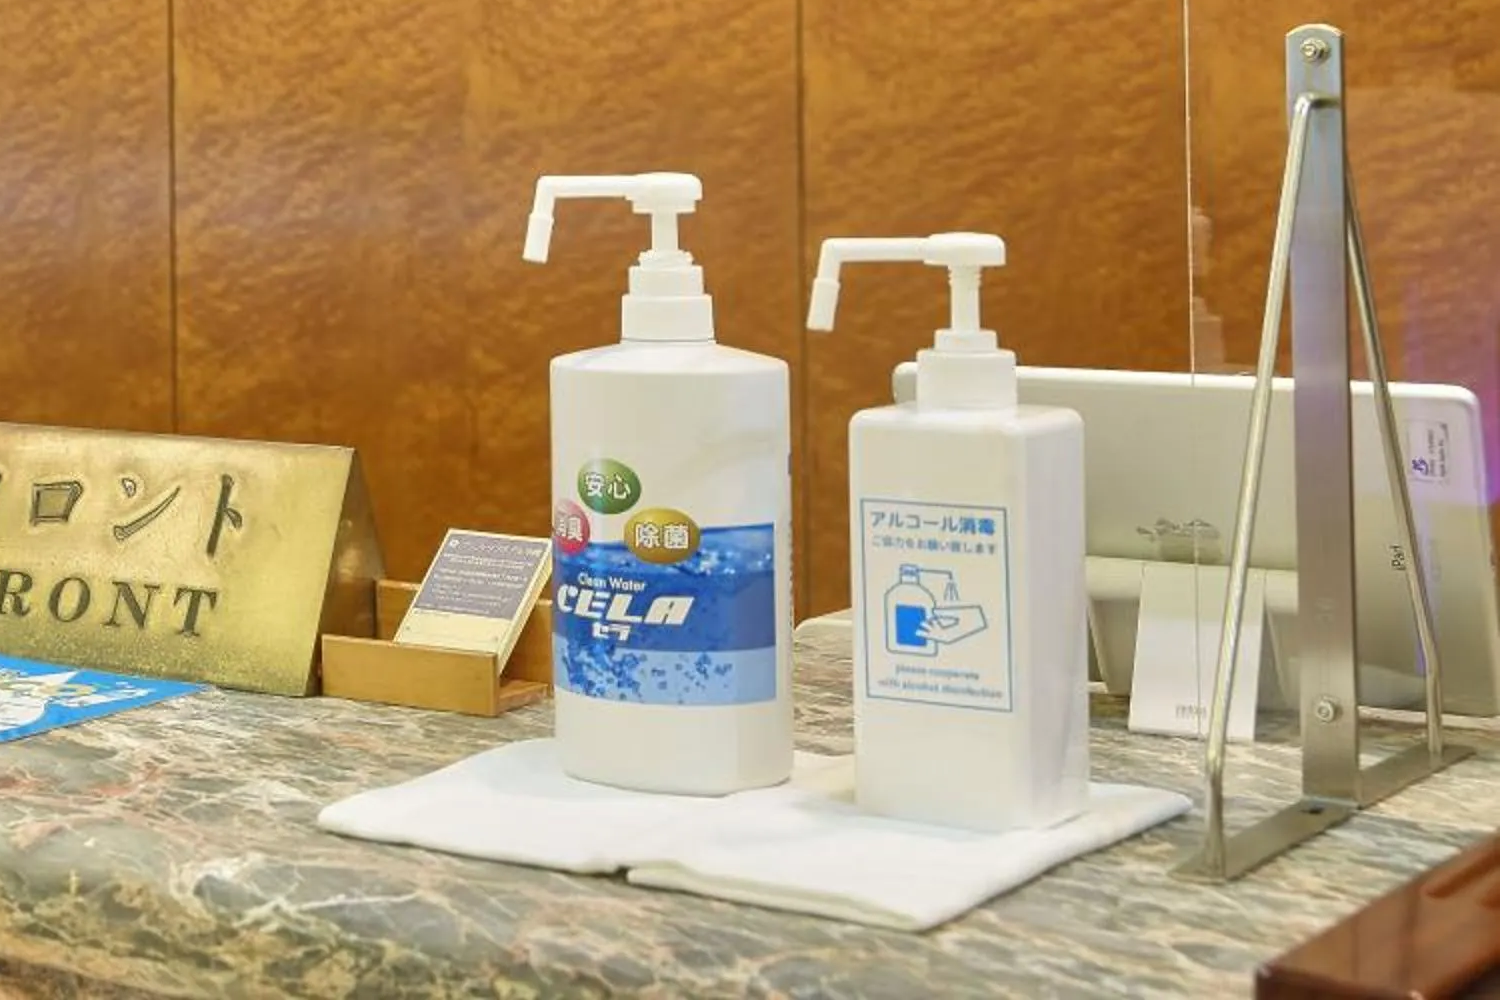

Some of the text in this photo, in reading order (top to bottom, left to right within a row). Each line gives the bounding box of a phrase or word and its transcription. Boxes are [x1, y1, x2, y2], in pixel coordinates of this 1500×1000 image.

[584, 472, 632, 500] 安心
[635, 520, 689, 549] 除菌
[871, 511, 995, 536] アルコール消毒
[577, 572, 646, 592] Clean Water
[557, 583, 695, 625] CELA
[592, 621, 631, 641] セラ
